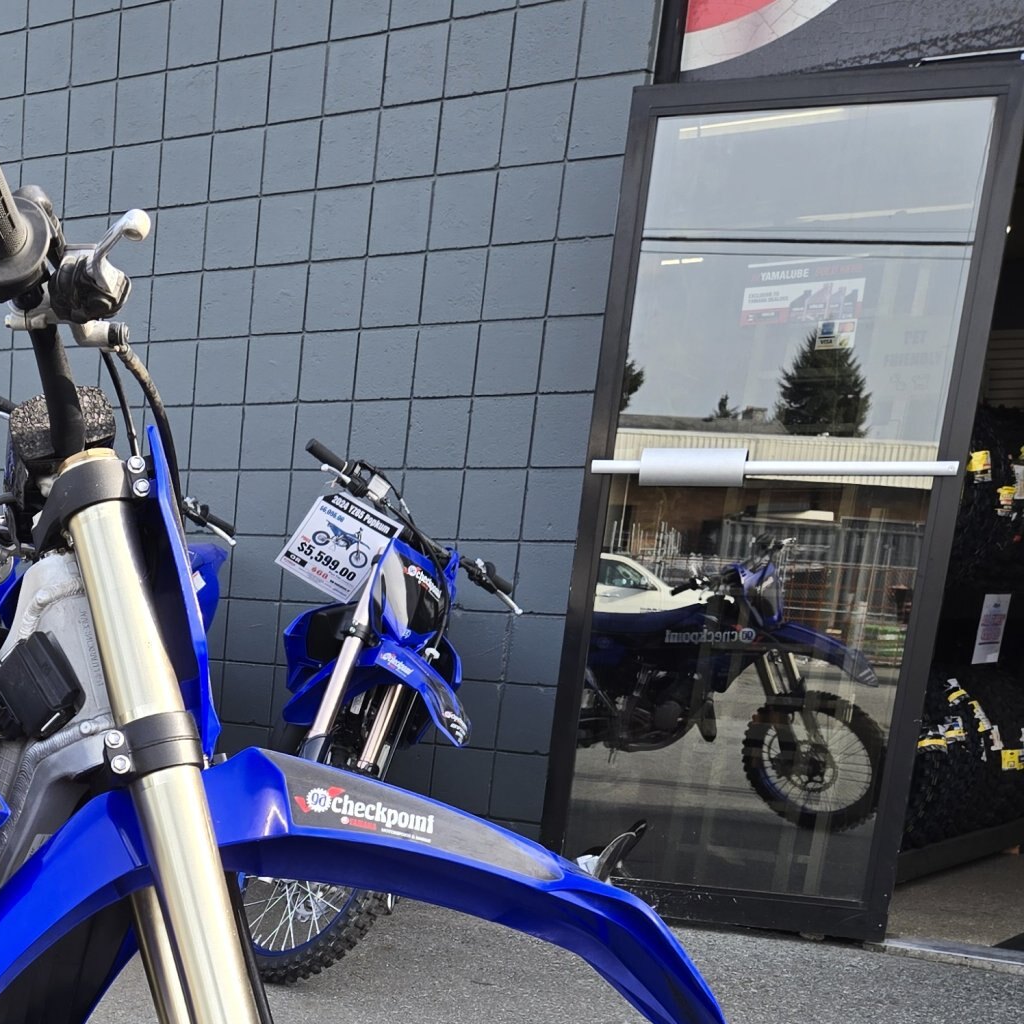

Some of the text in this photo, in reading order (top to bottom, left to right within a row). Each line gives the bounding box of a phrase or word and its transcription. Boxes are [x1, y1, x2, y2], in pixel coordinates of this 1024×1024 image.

[760, 268, 810, 281] YAMALUBE
[331, 496, 349, 512] 2024
[363, 511, 391, 536] Popkum
[289, 553, 302, 564] OR
[297, 541, 358, 582] $5,599.00
[332, 796, 434, 834] checkpoint
